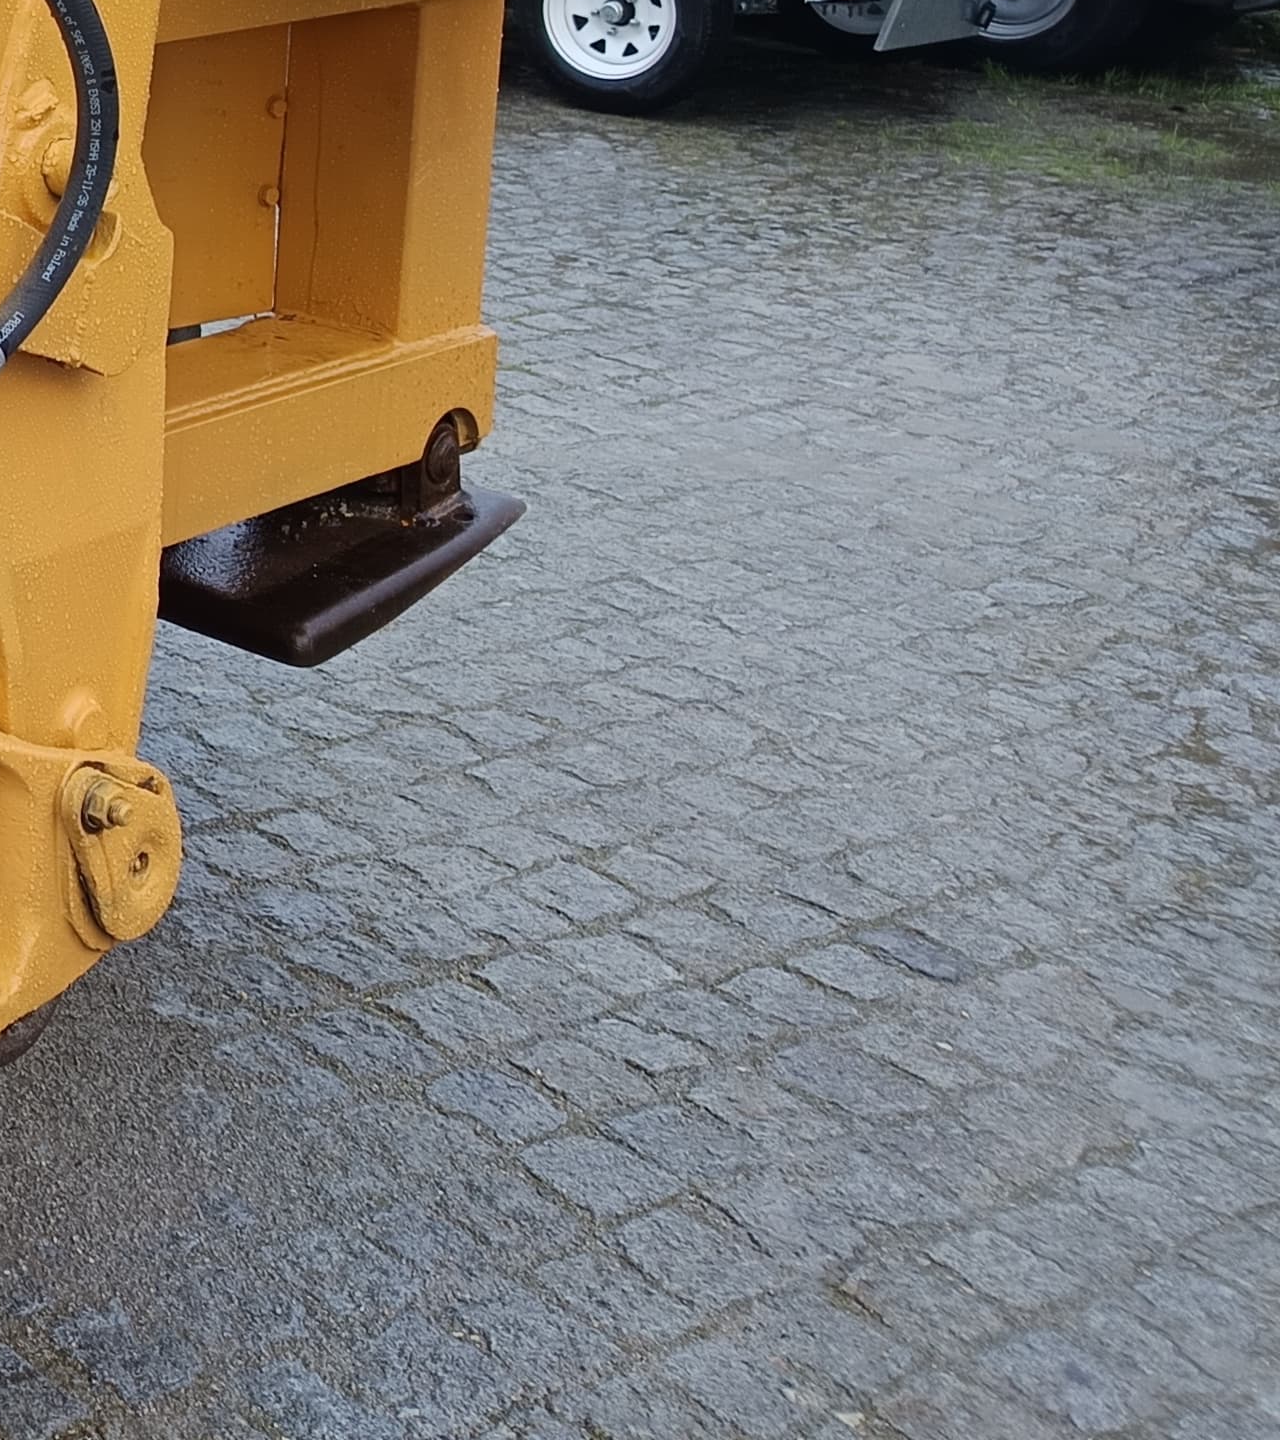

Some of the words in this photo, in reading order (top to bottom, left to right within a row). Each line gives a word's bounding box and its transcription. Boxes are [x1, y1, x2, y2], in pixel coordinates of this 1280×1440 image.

[70, 27, 84, 46] SAE
[87, 138, 99, 160] MSHA
[66, 208, 84, 232] Made
[42, 248, 66, 282] Poland
